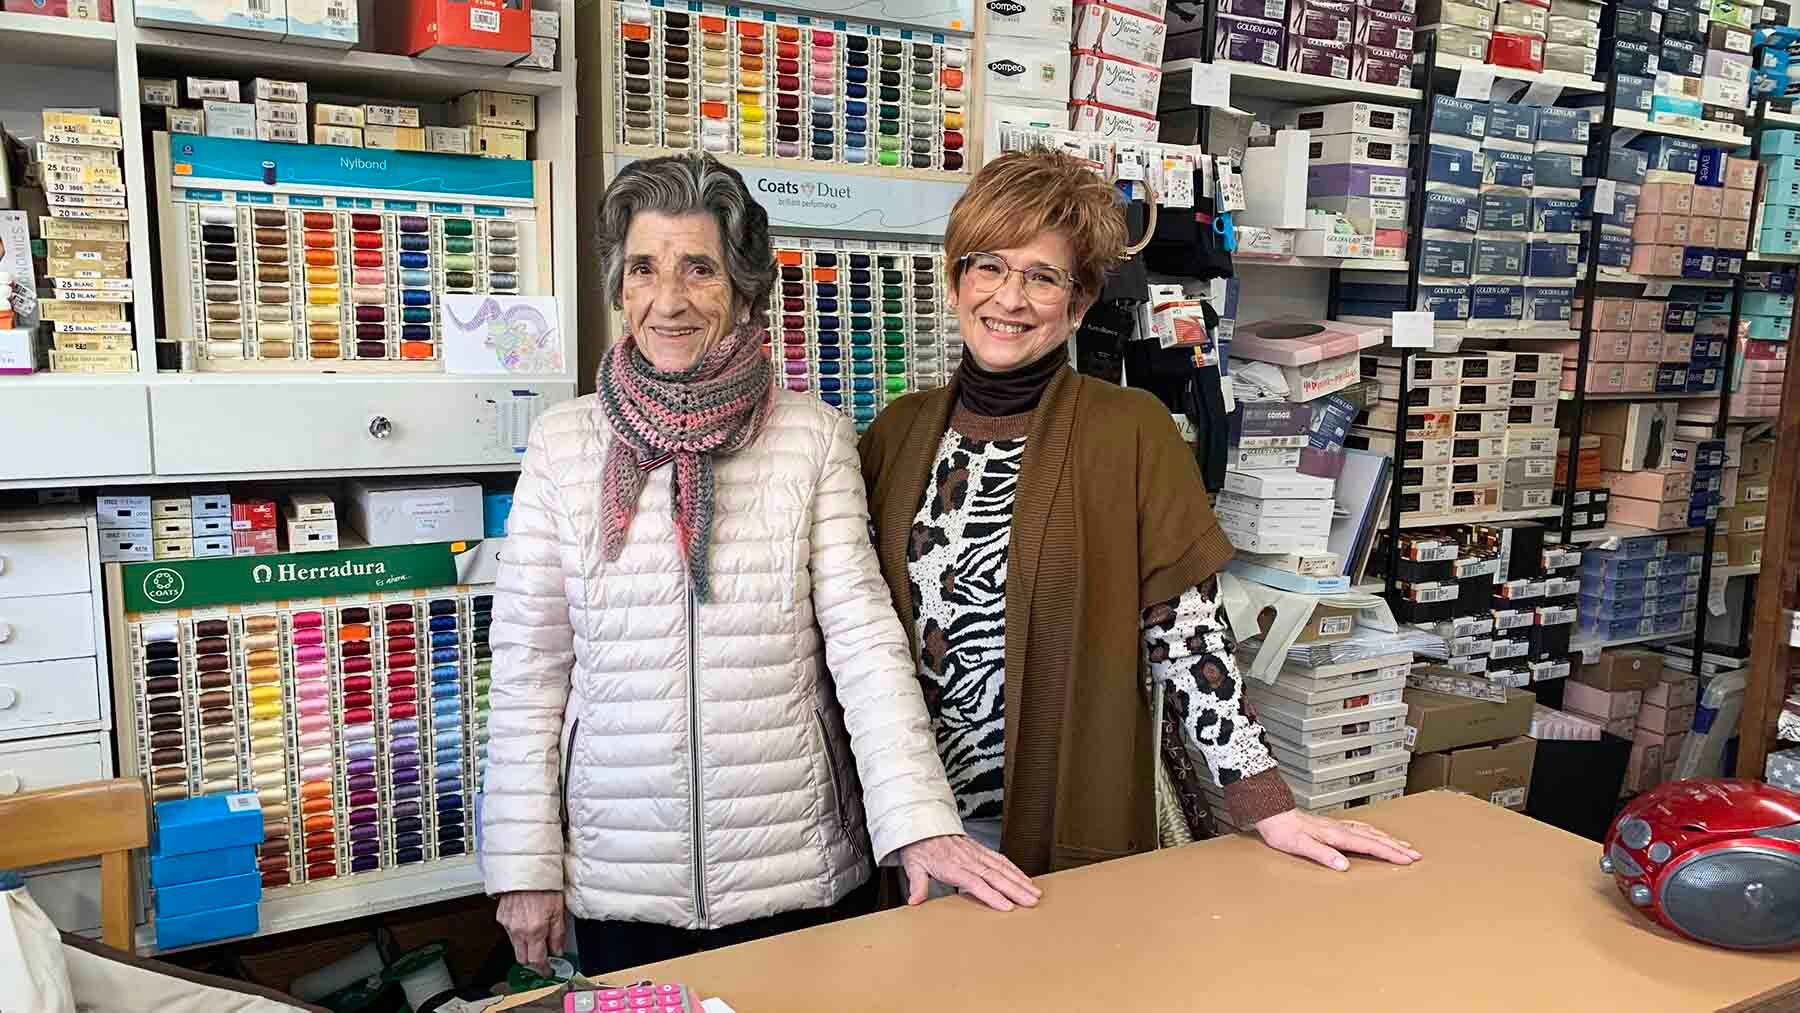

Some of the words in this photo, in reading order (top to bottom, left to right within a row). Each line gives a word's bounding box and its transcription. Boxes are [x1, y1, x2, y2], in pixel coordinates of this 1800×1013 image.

[990, 2, 1022, 13] pompea
[1376, 10, 1397, 20] GOLDEN
[1398, 14, 1412, 23] LADY
[1236, 22, 1261, 33] GOLDEN
[1261, 26, 1280, 36] LADY
[1372, 49, 1395, 58] GOLDEN
[1395, 52, 1409, 60] LADY
[991, 62, 1023, 73] pompea
[49, 134, 60, 142] 25
[47, 164, 58, 172] 25
[340, 156, 388, 171] Nylbond
[54, 183, 65, 191] 30
[757, 178, 799, 194] Coats
[816, 181, 852, 199] Duet
[55, 195, 66, 203] 25
[58, 209, 70, 217] 20
[62, 280, 73, 288] 25
[65, 292, 76, 300] 30
[64, 324, 74, 332] 25
[277, 560, 386, 582] Herradura
[149, 588, 179, 598] COATS
